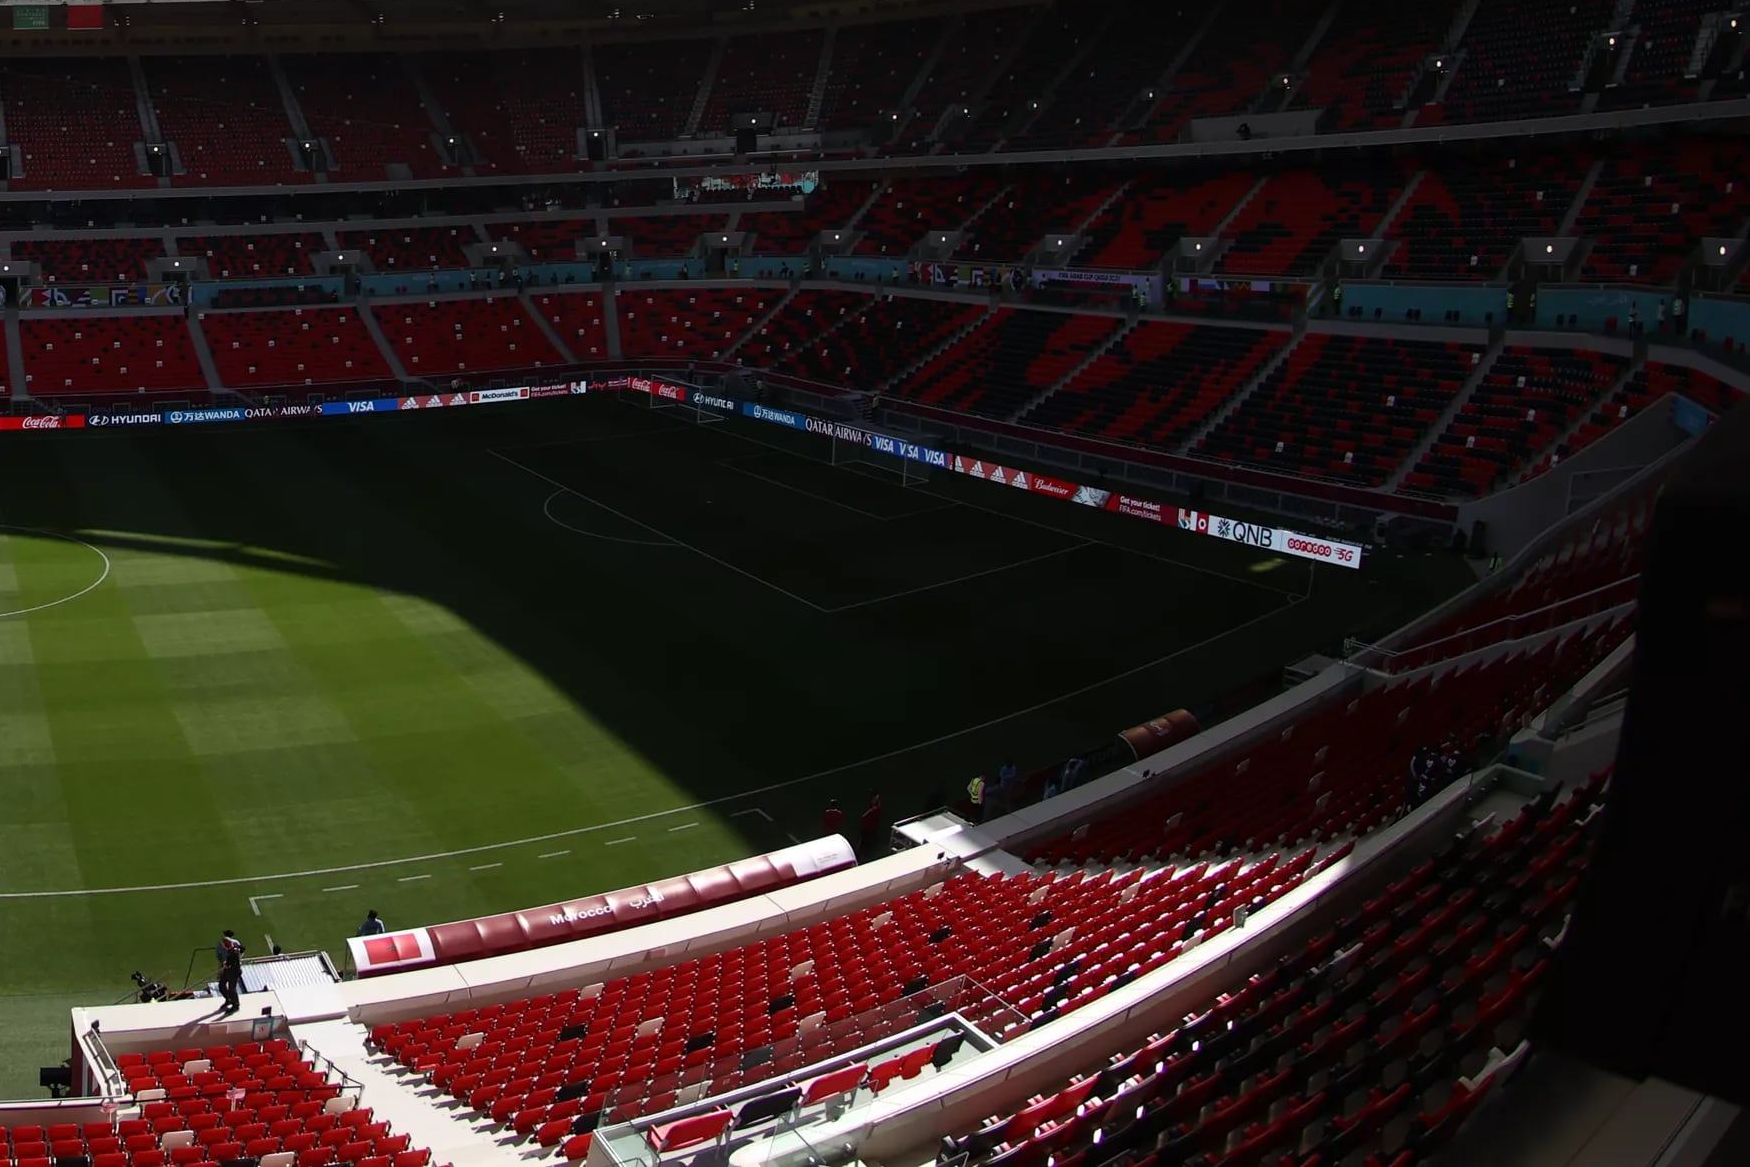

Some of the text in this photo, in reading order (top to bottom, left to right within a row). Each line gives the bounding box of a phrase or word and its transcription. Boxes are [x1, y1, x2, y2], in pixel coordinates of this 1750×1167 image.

[482, 391, 518, 400] McDonald's
[347, 401, 375, 412] VISA
[111, 414, 161, 424] HYUNDAI
[805, 417, 833, 436] QATAR
[874, 436, 894, 452] VISA
[923, 448, 945, 466] VISA
[1033, 477, 1069, 495] Budweiser
[1120, 495, 1129, 505] Get
[1130, 498, 1142, 509] your
[1119, 505, 1162, 522] FIFA.com/tickets
[1233, 521, 1273, 547] QNB
[1288, 538, 1354, 562] ooredoo 5G
[549, 904, 613, 925] Morocco
